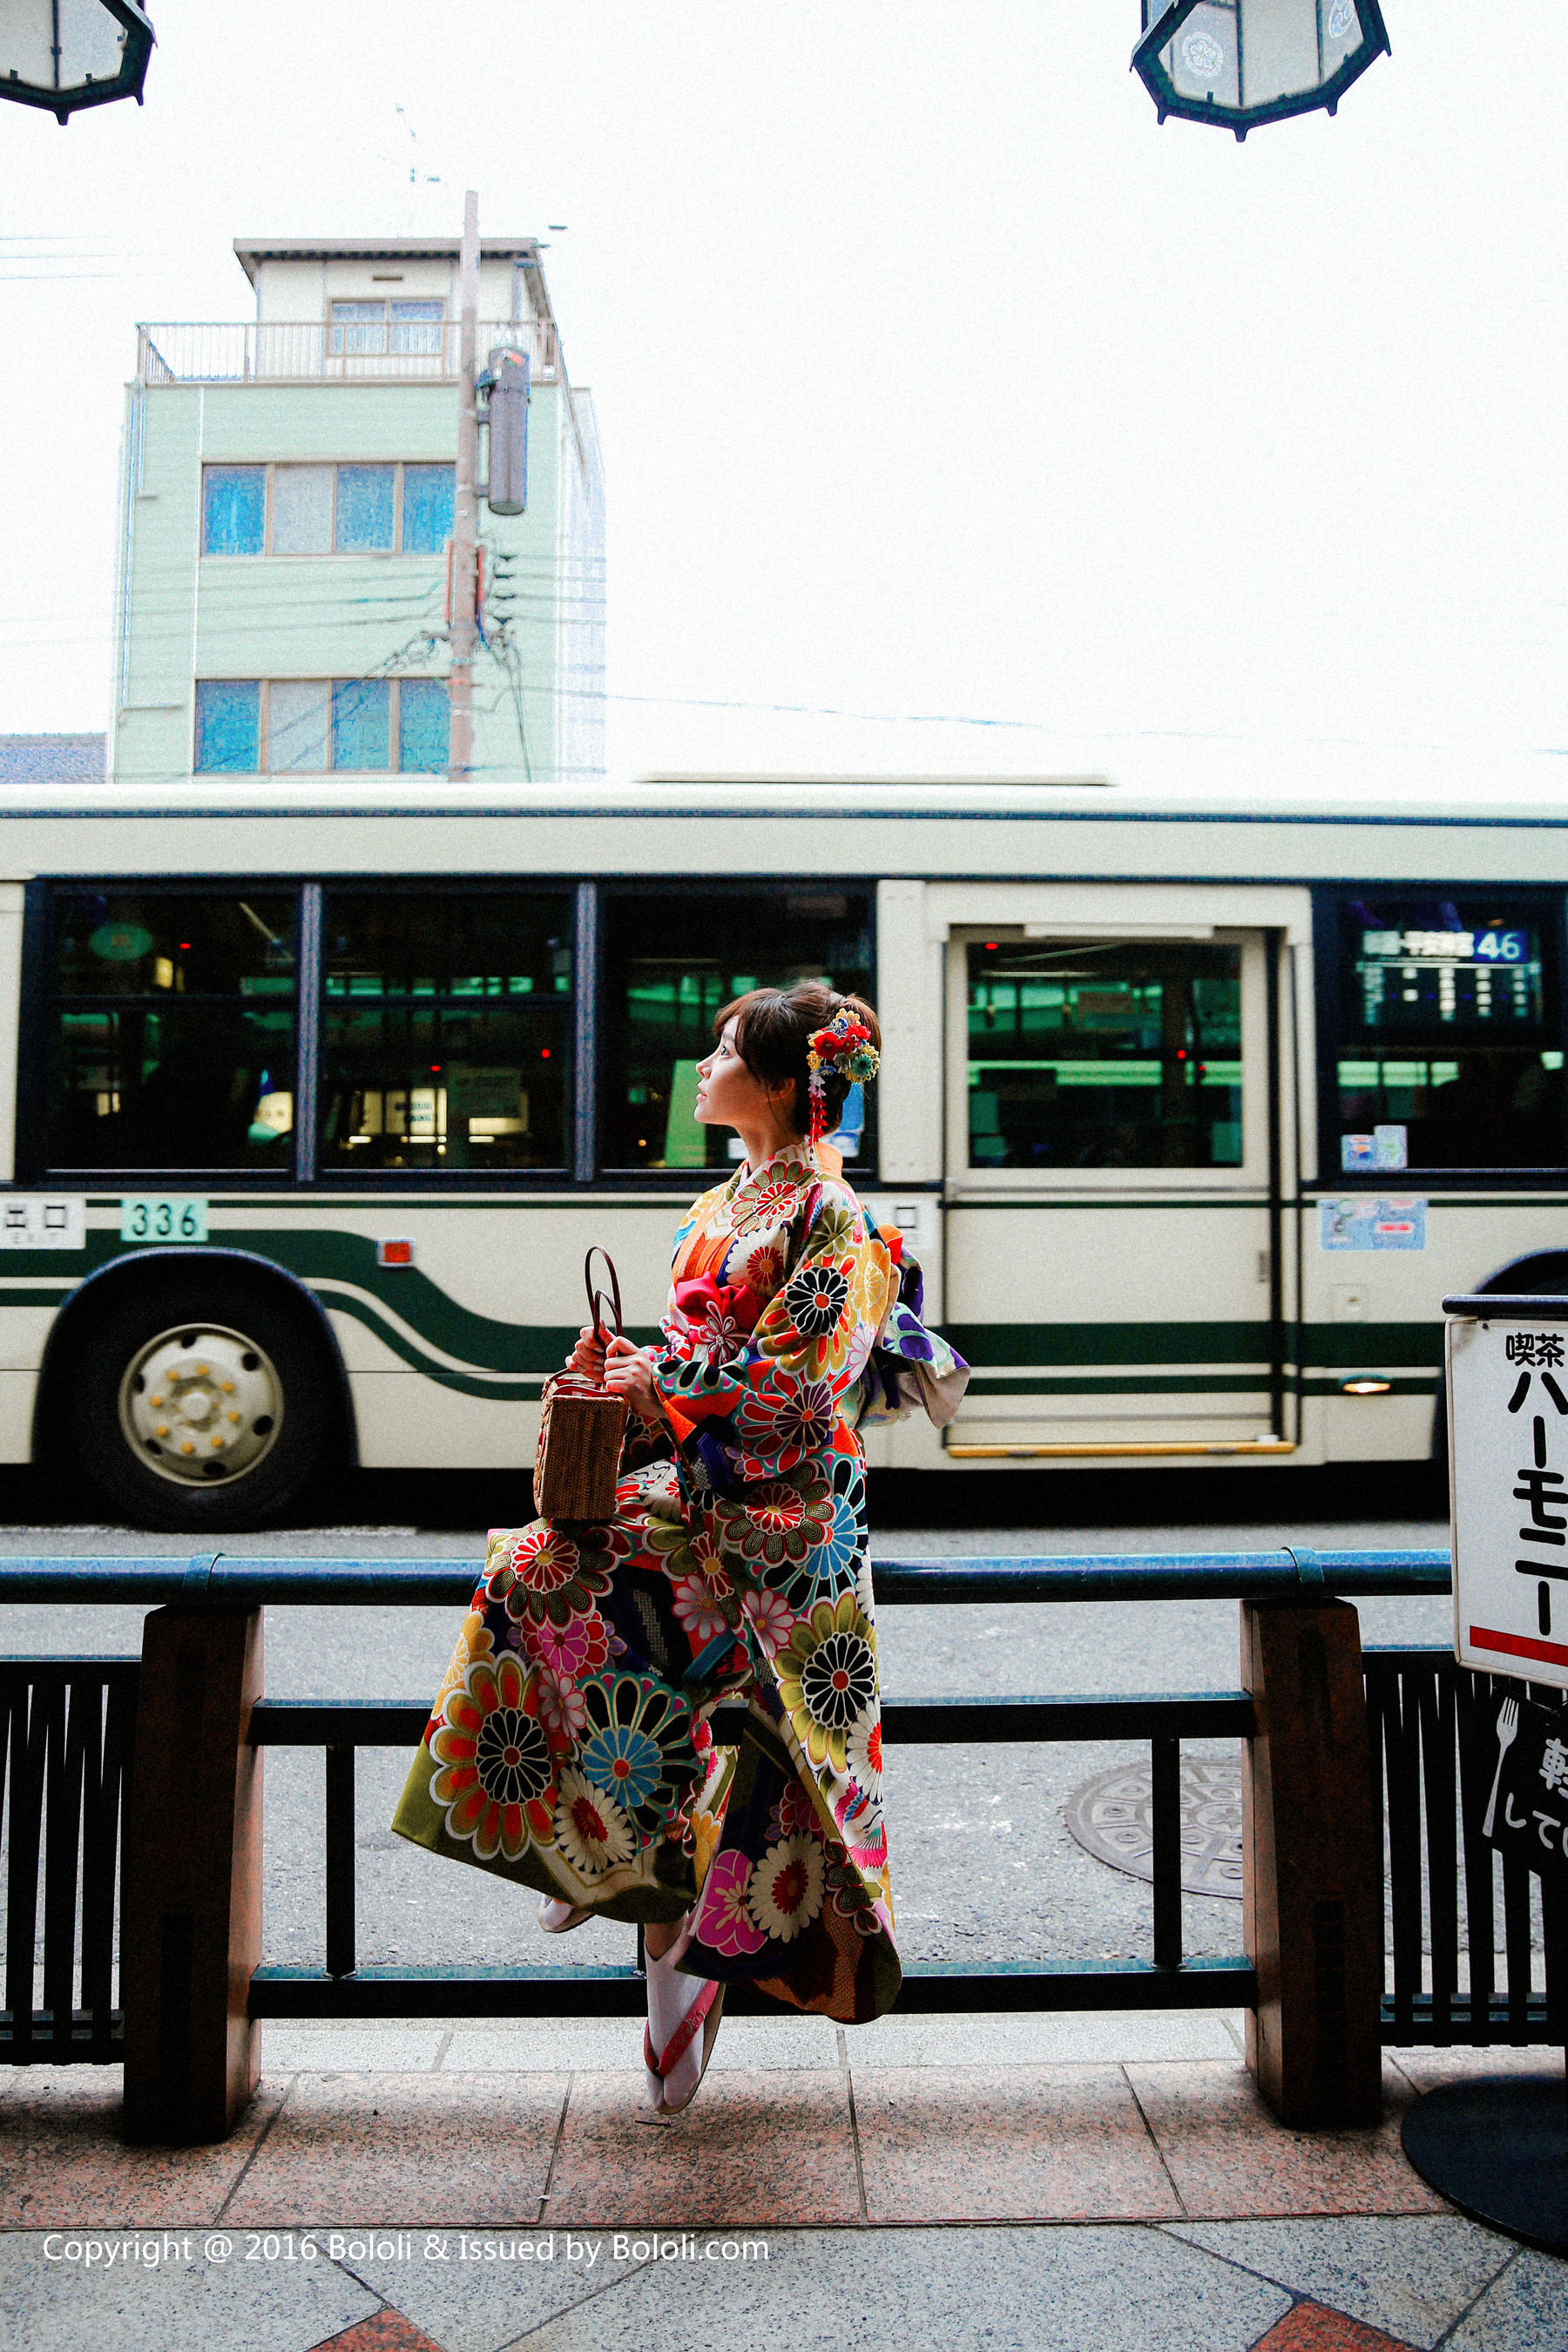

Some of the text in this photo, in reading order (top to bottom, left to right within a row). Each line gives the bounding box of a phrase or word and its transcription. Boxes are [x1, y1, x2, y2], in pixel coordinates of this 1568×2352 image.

[1477, 930, 1520, 960] 46
[132, 1202, 198, 1237] 336
[1505, 1332, 1565, 1368] 喫茶
[1506, 1370, 1568, 1637] ハーモニー
